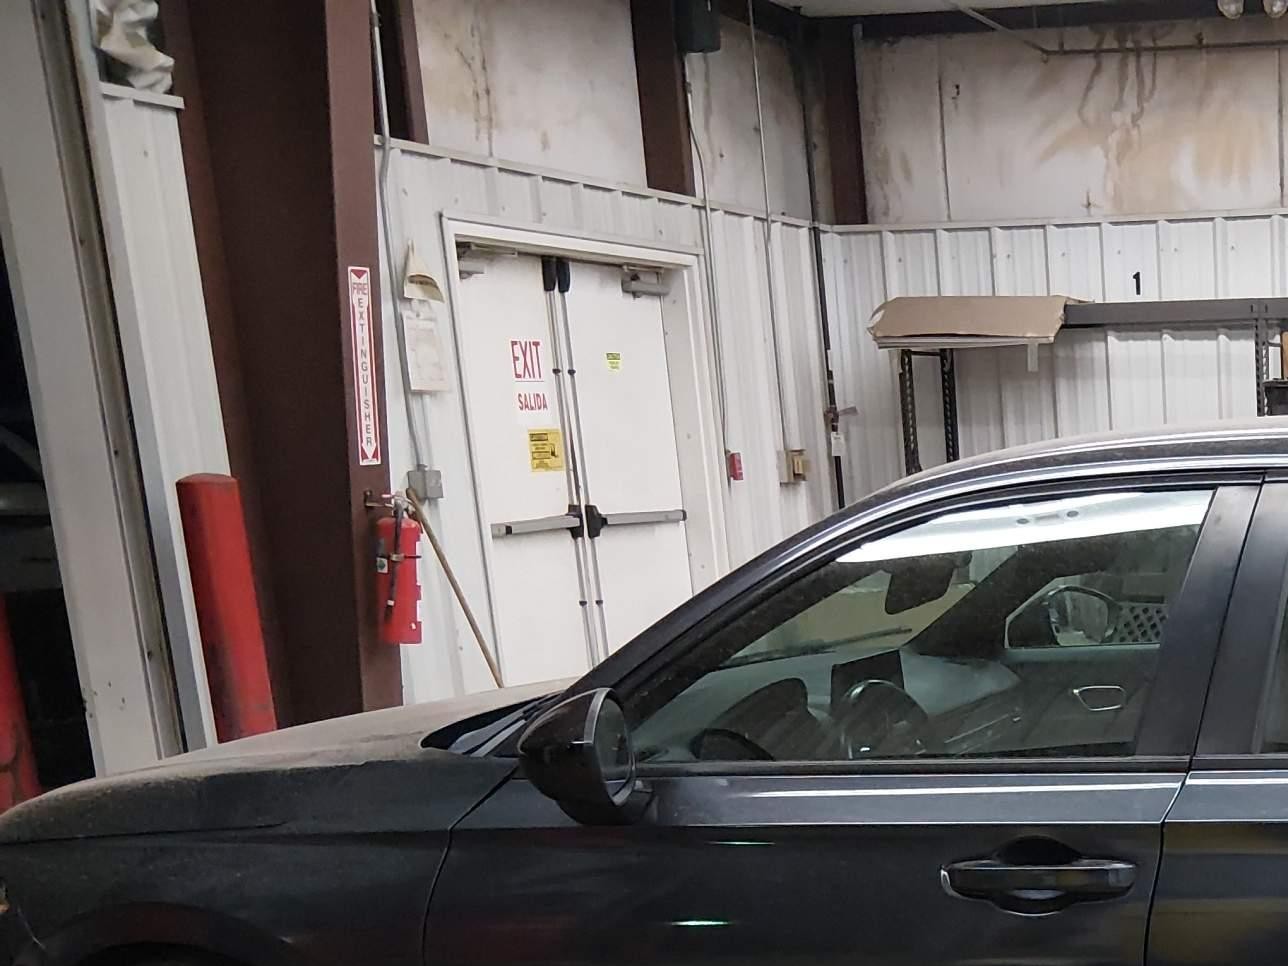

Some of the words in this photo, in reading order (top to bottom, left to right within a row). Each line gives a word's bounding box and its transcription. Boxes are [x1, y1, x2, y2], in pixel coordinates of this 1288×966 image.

[352, 282, 369, 296] FIRE
[1132, 271, 1141, 296] 1
[357, 297, 373, 447] EXTINGUISHER
[510, 340, 542, 379] EXIT
[517, 392, 548, 411] SALIDA
